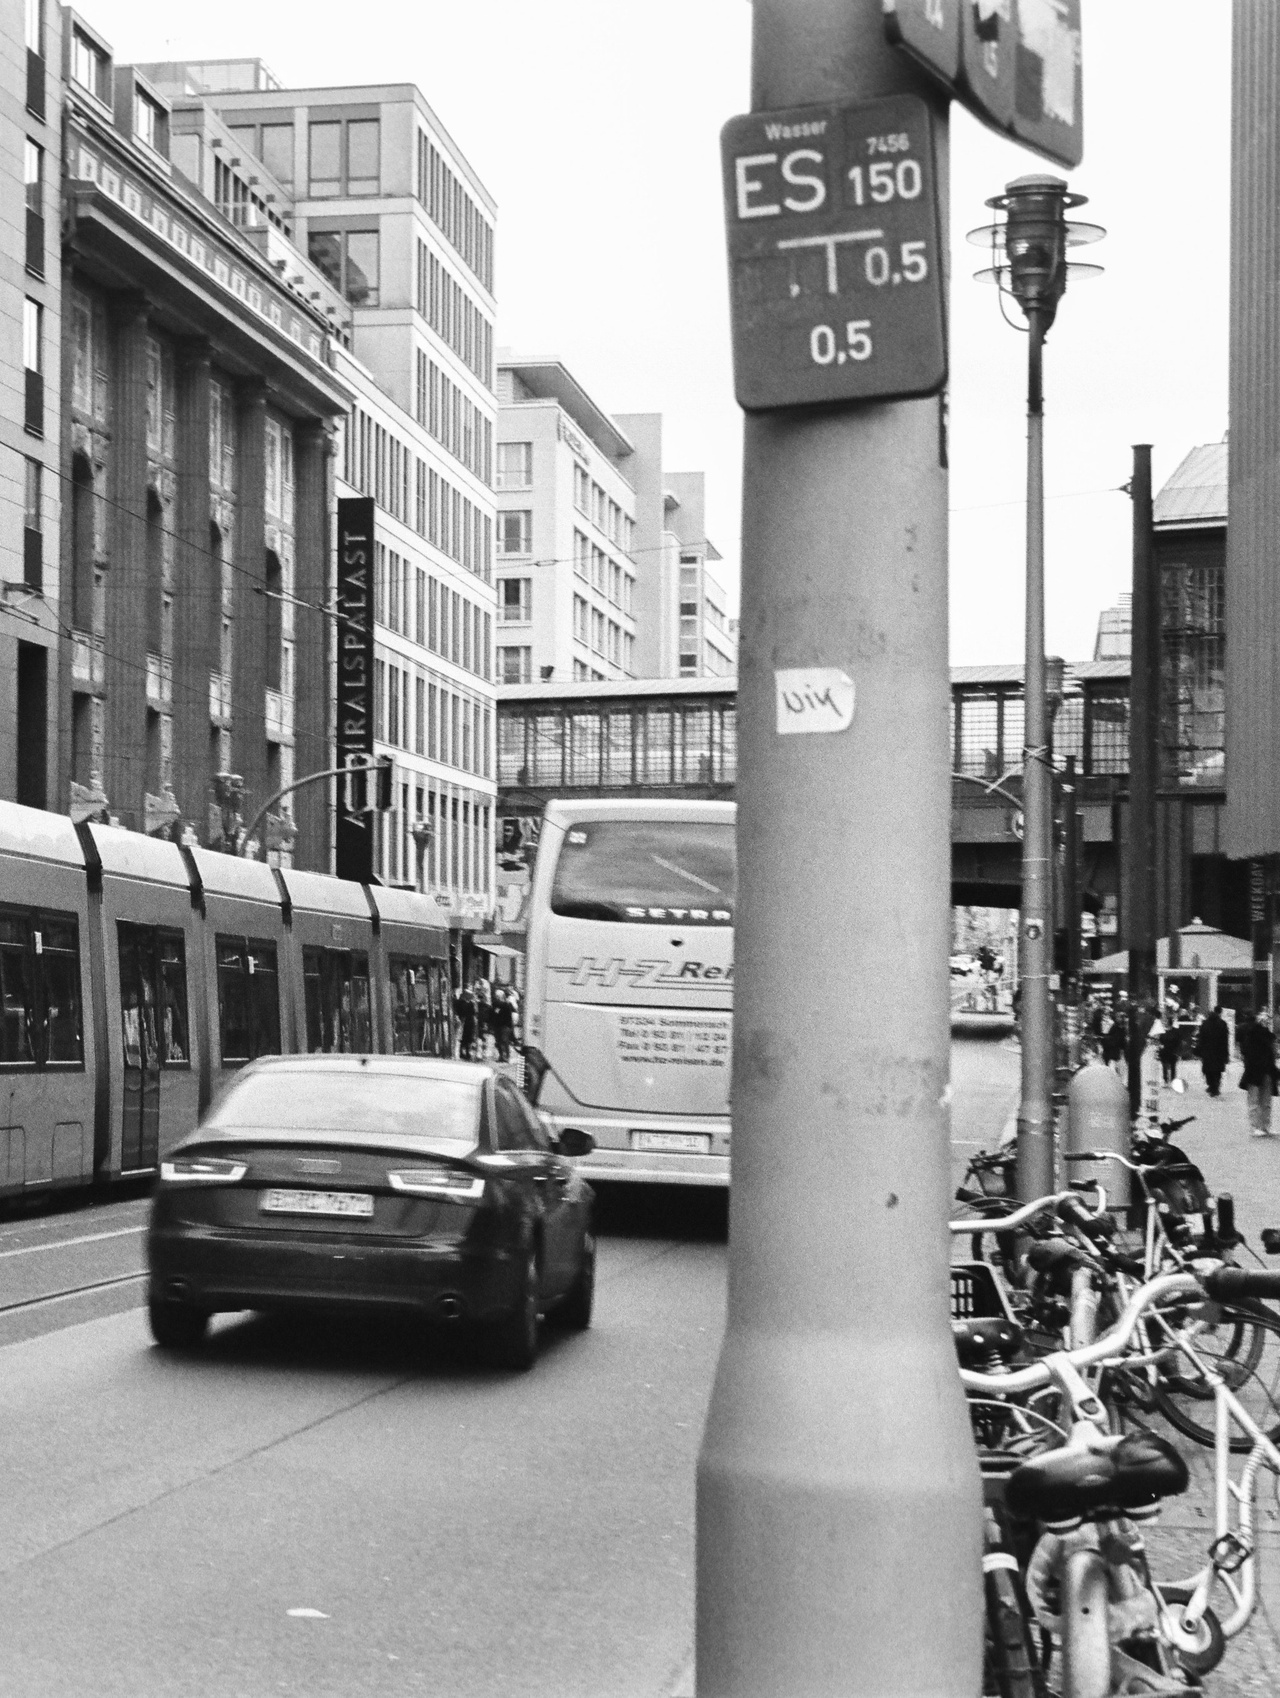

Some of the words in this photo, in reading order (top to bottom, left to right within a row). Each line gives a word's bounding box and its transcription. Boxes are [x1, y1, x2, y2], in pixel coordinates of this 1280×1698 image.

[765, 120, 827, 140] Wasser
[736, 149, 826, 218] ES
[848, 159, 922, 205] 150
[865, 241, 928, 286] 0,5
[810, 319, 872, 365] 0,5
[626, 907, 731, 920] SETRA
